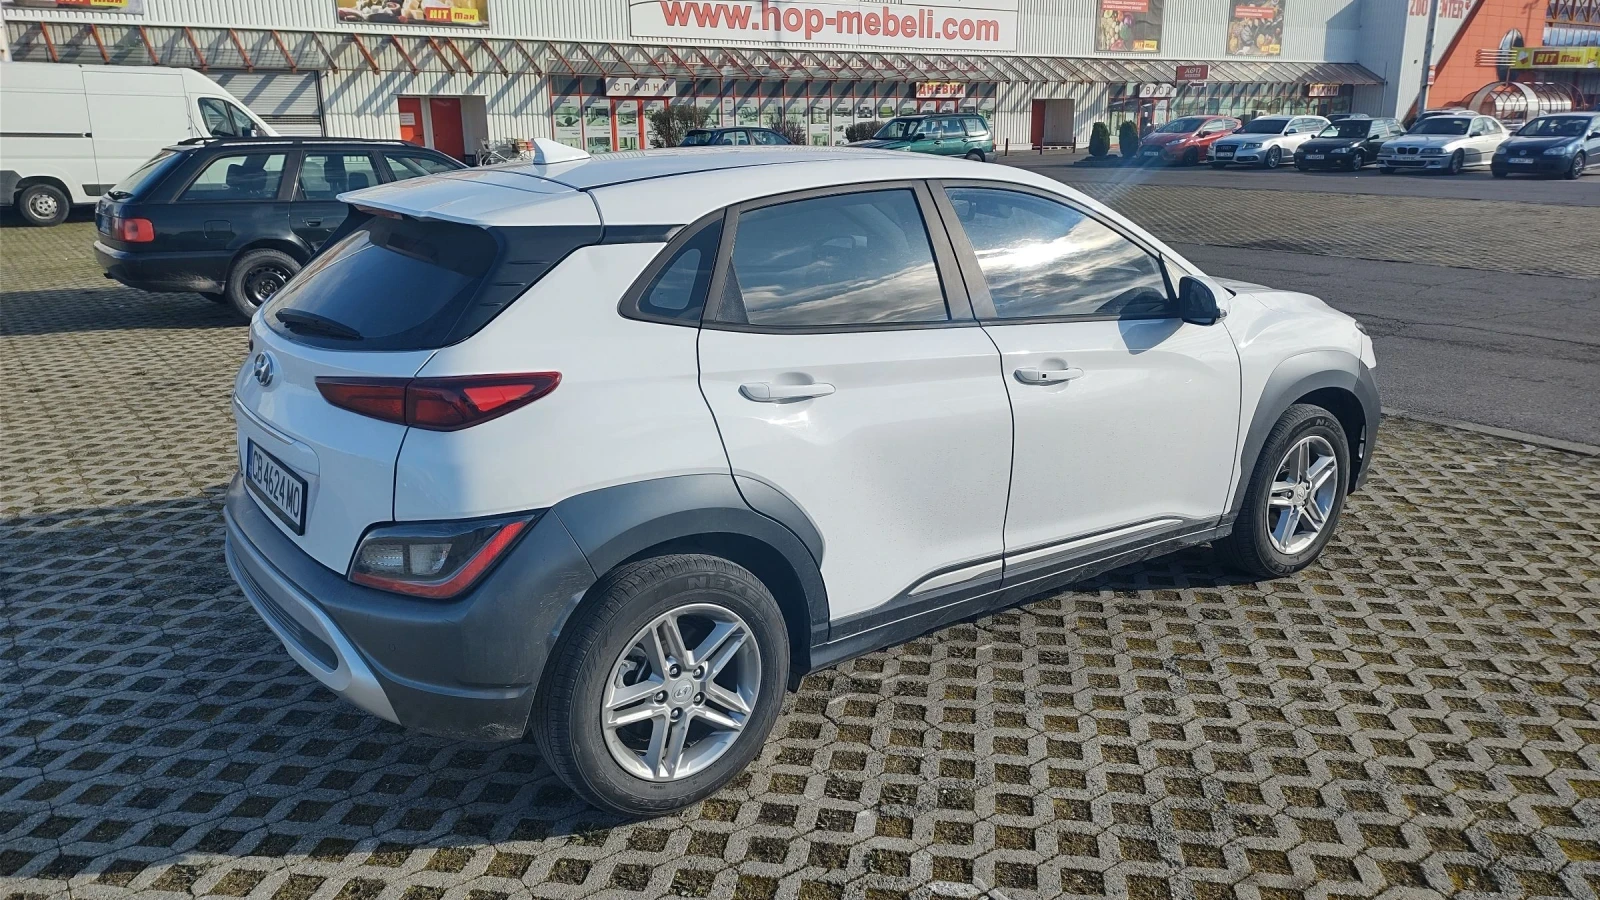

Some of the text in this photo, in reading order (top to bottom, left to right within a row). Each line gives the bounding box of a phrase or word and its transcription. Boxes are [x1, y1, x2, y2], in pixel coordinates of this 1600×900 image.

[429, 9, 449, 19] HIT
[660, 0, 999, 41] www.hop-mebeli.com
[1536, 53, 1556, 63] HIT
[613, 82, 669, 92] СПАЛНИ
[918, 83, 964, 97] ДНЕВНИ
[1145, 86, 1172, 95] ВХОД
[1310, 85, 1338, 96] КУХНИ
[253, 450, 300, 518] CB 4624 MO
